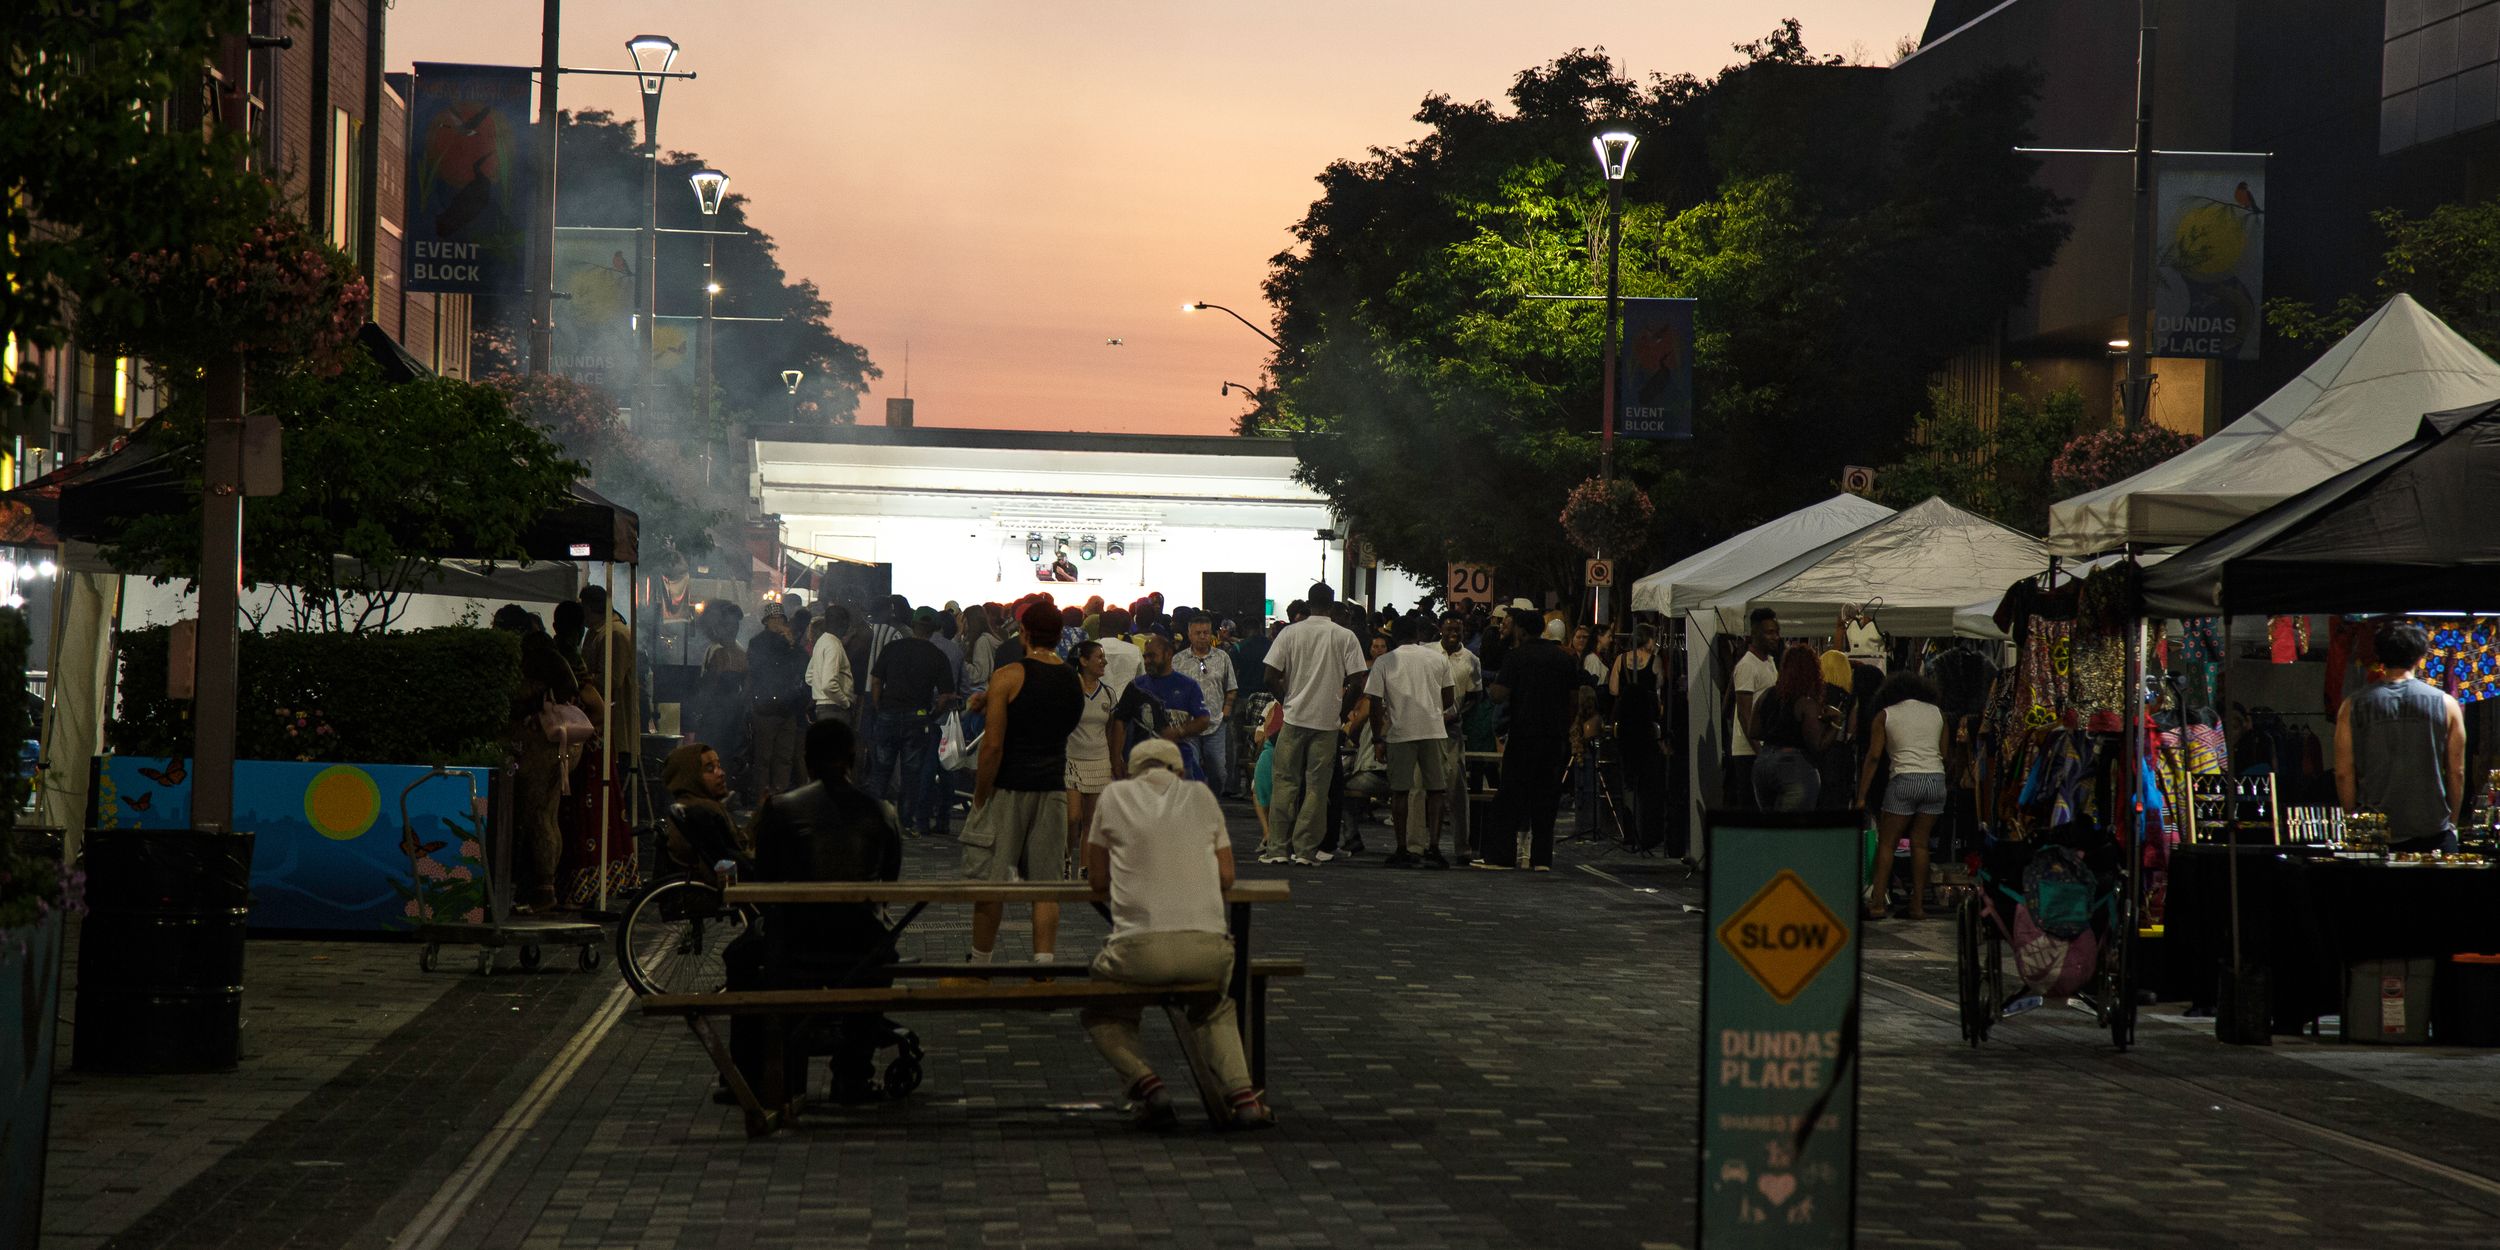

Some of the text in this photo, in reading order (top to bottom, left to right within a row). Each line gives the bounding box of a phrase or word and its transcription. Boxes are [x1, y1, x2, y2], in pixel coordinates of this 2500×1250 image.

[415, 240, 480, 260] EVENT
[414, 263, 480, 281] BLOCK
[2158, 316, 2237, 333] DUNDAS
[2158, 337, 2222, 353] PLACE
[554, 354, 616, 369] DUNDAS
[1625, 406, 1665, 418] EVENT
[1624, 420, 1665, 432] BLOCK
[1454, 568, 1490, 594] 20
[1741, 922, 1830, 950] SLOW
[1720, 1028, 1842, 1060] DUNDAS
[1720, 1059, 1821, 1089] PLACE
